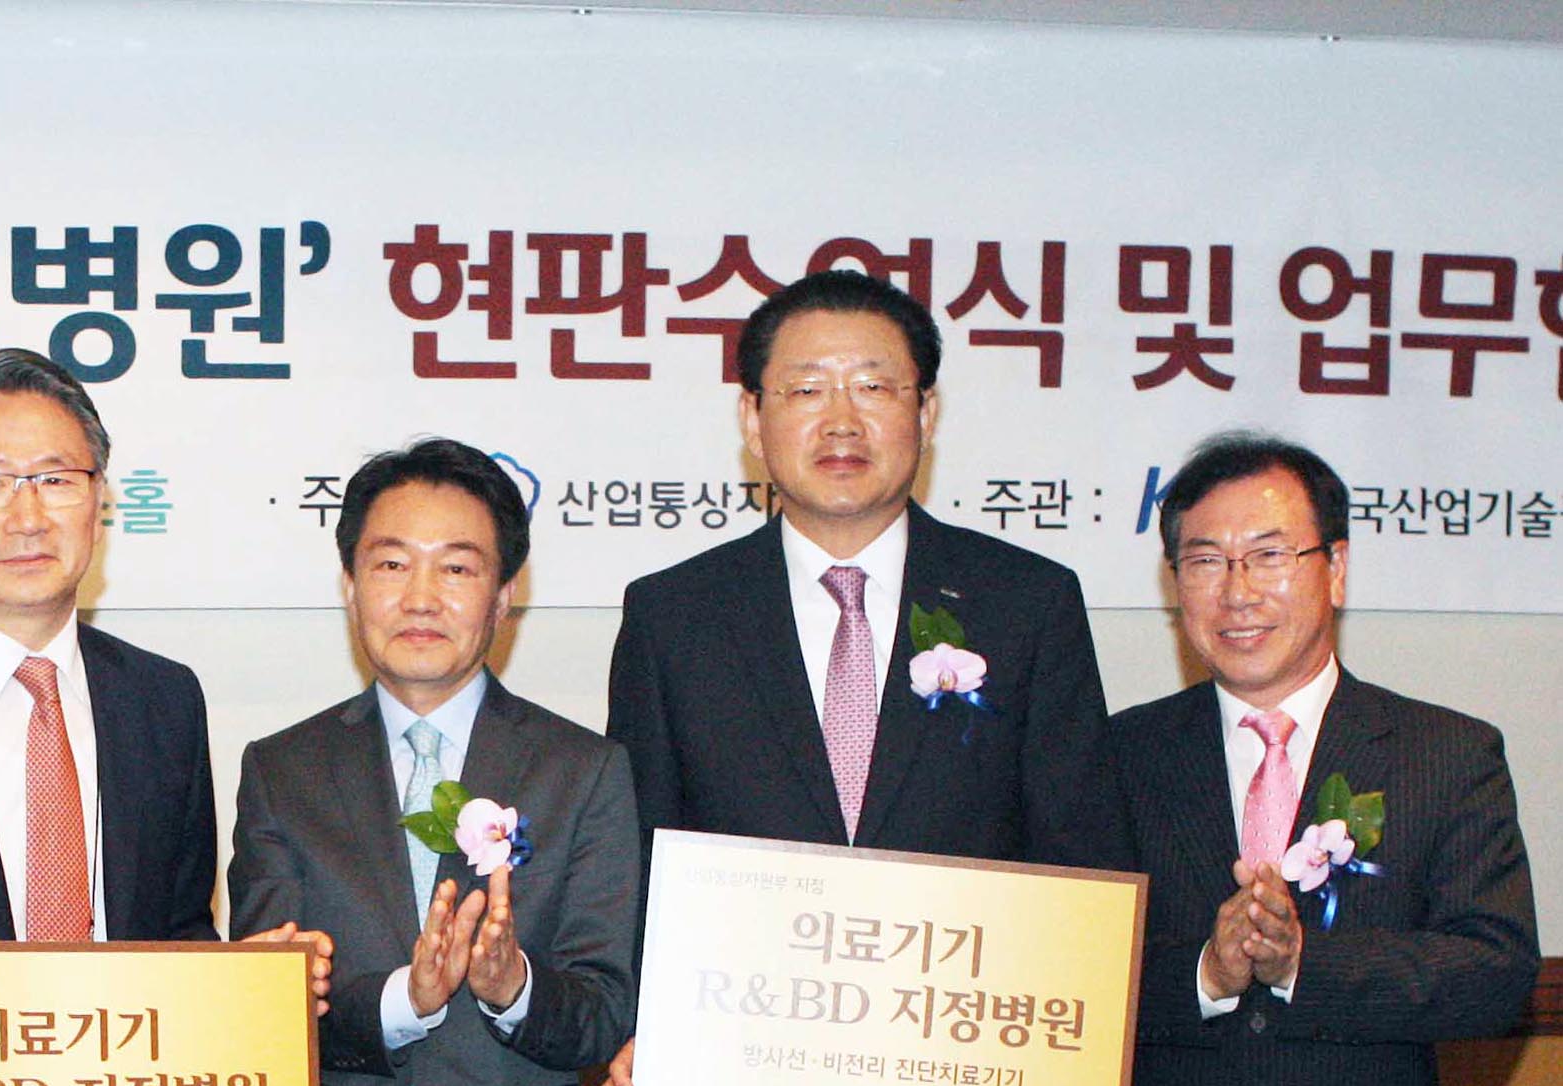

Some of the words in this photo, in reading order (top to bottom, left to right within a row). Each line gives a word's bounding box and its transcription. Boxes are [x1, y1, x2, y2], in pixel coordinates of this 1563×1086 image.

[1117, 244, 1236, 392] 및
[1279, 246, 1563, 398] 업무
[557, 479, 780, 529] 산업통상자
[981, 480, 1073, 531] 주관
[1349, 486, 1563, 538] 국산업기술
[795, 877, 825, 895] 지정
[789, 910, 984, 979] 의료기기
[695, 968, 870, 1024] R&BD
[889, 985, 1085, 1051] 지정병원
